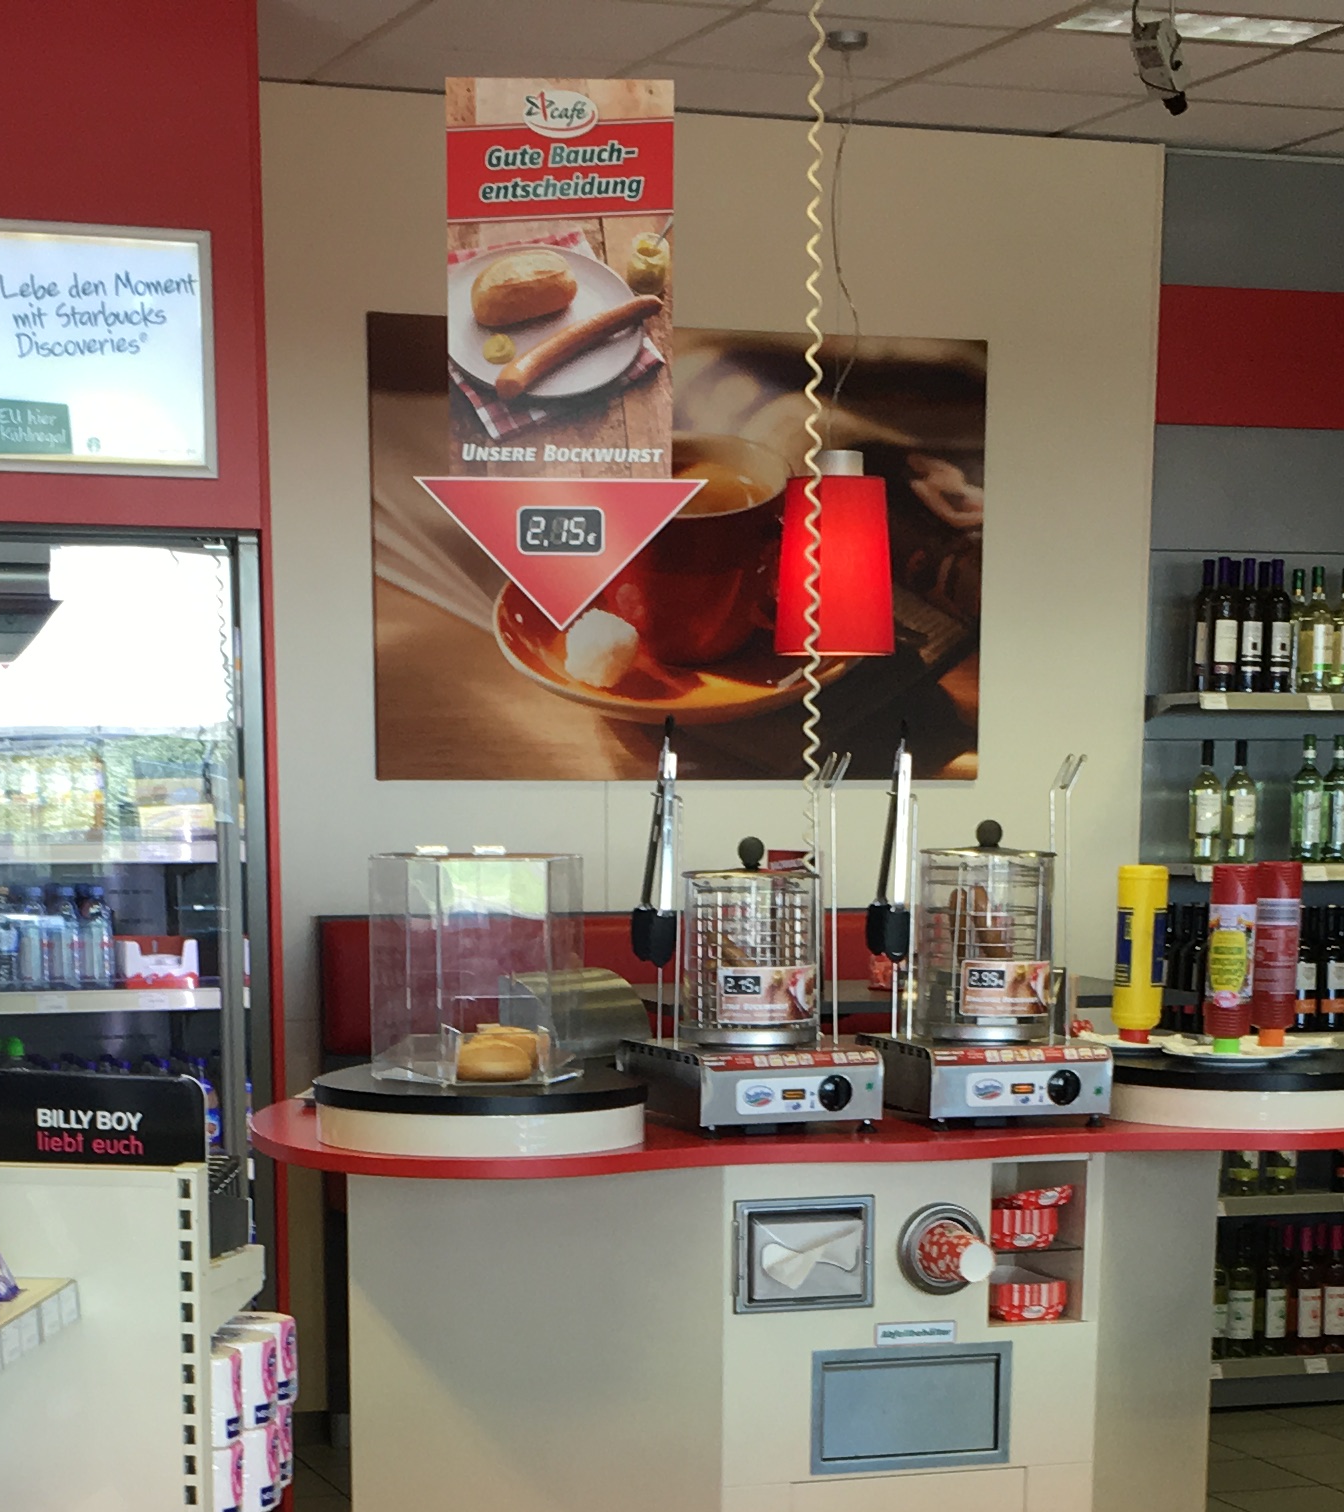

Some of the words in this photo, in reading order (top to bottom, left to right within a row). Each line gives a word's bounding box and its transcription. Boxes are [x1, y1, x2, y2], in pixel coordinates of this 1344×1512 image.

[550, 100, 588, 126] café
[487, 146, 542, 169] Gute
[549, 141, 638, 168] Bauch-
[480, 174, 644, 202] entscheidung
[68, 272, 107, 298] den
[114, 270, 198, 297] Moment
[12, 303, 46, 329] mit
[56, 302, 167, 329] Starbucks
[27, 405, 57, 426] hier
[36, 1108, 92, 1132] BILLY
[96, 1109, 143, 1133] BOY
[36, 1130, 84, 1155] liebt
[92, 1133, 144, 1157] euch
